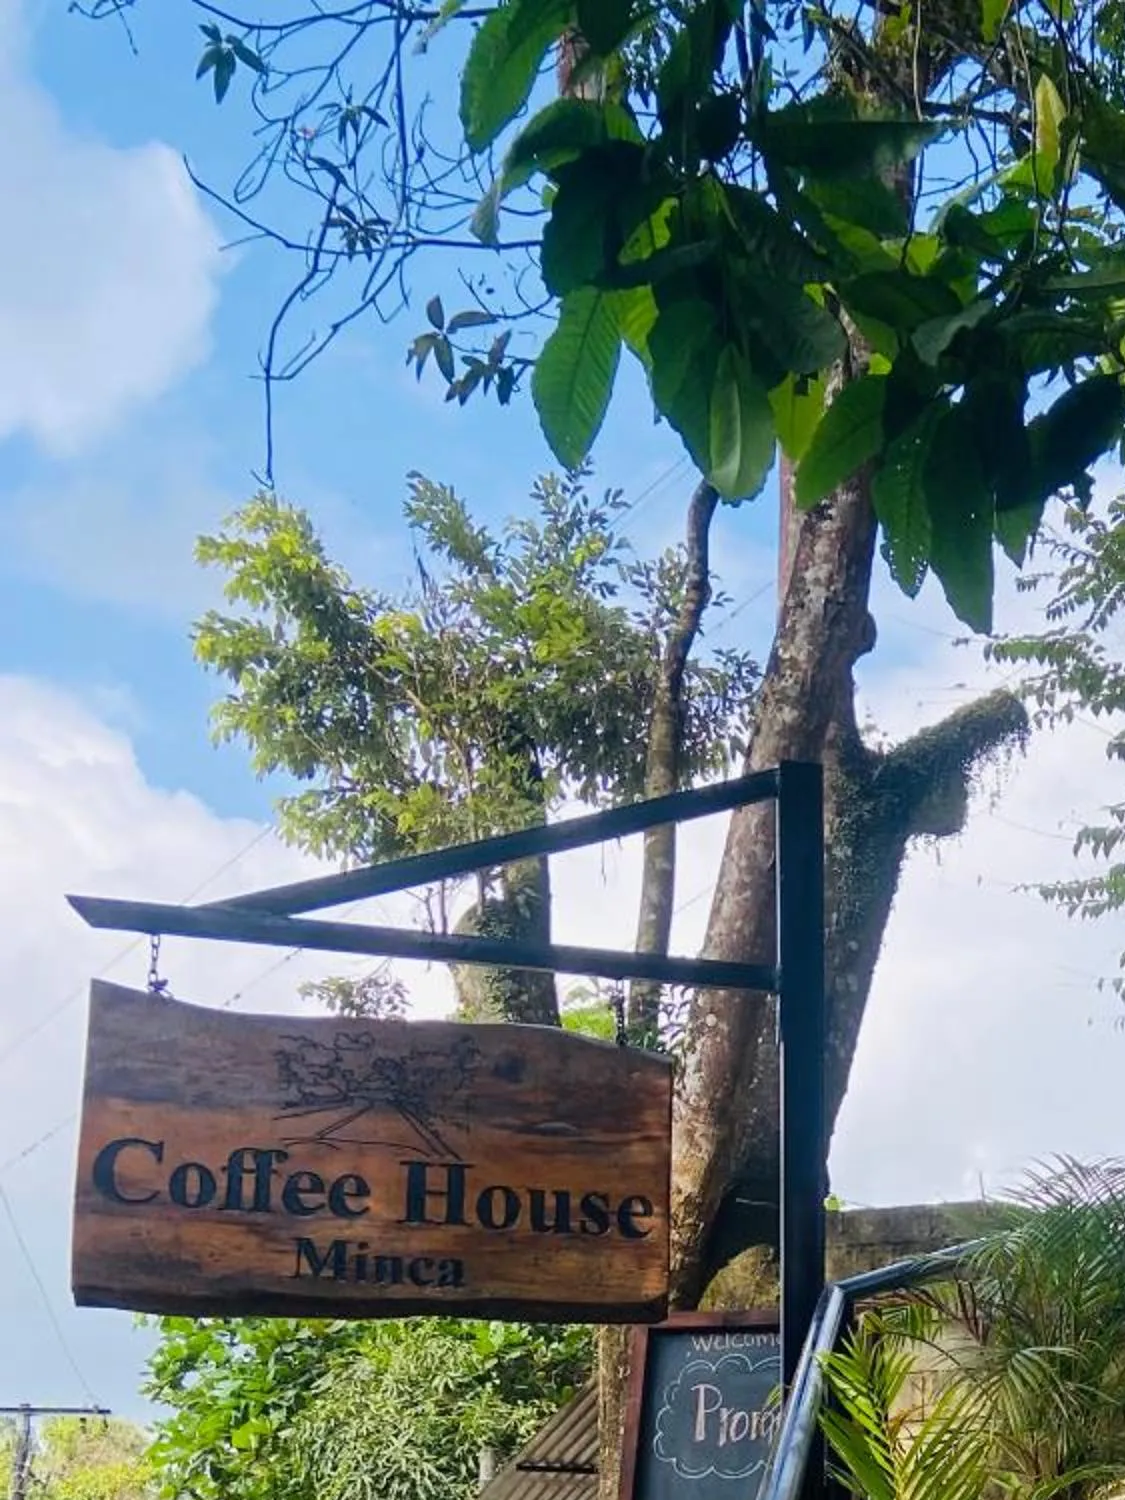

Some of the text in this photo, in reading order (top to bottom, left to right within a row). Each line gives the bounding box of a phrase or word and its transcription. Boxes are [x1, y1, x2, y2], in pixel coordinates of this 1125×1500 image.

[92, 1138, 654, 1239] Coffee House
[288, 1237, 466, 1288] Minca
